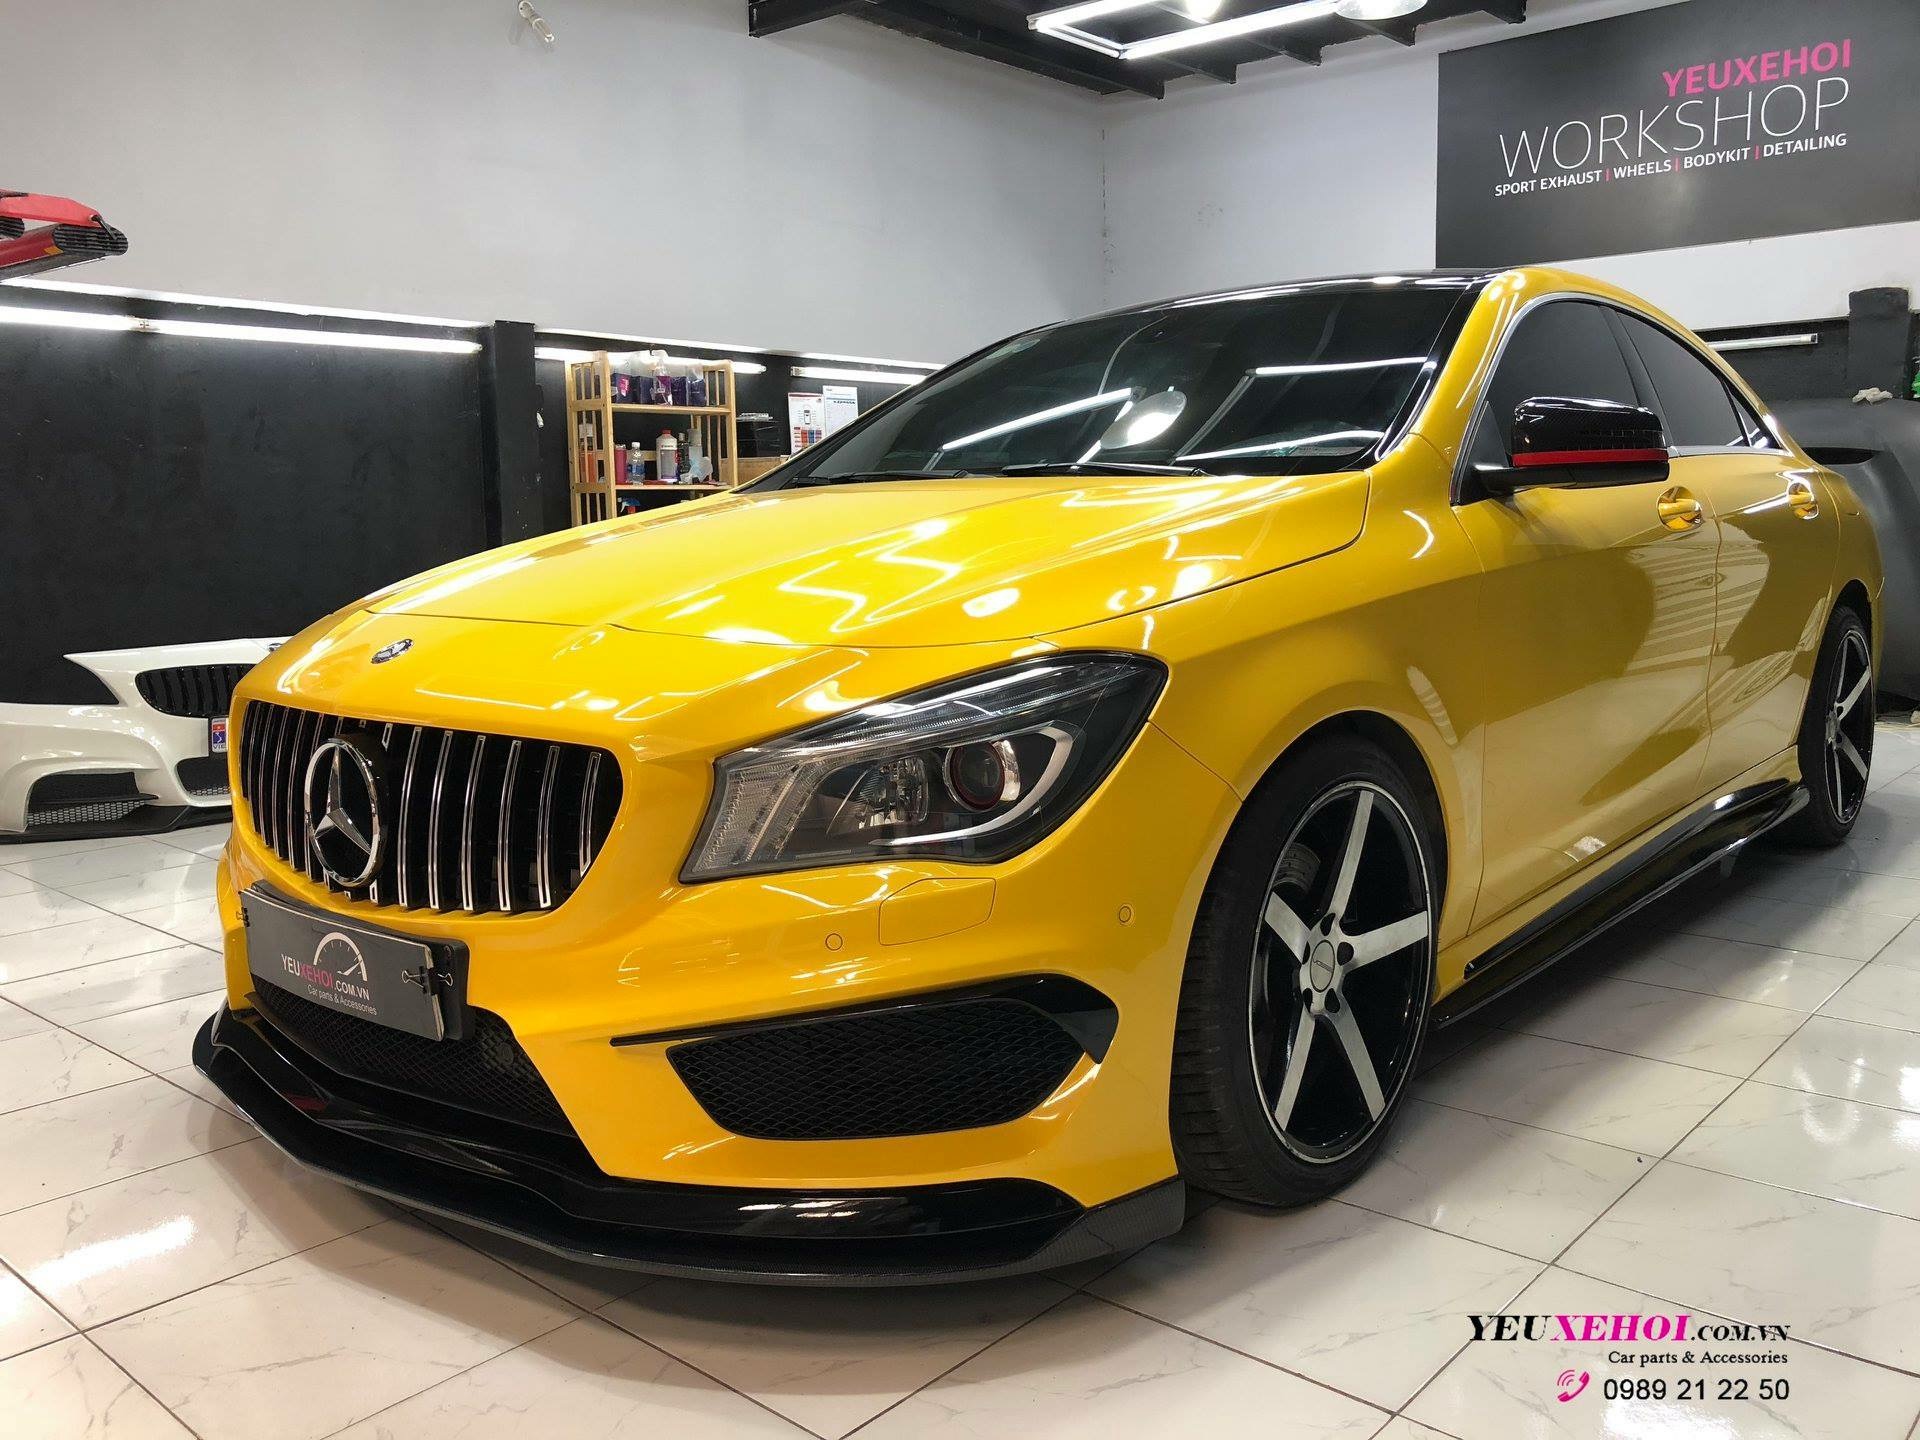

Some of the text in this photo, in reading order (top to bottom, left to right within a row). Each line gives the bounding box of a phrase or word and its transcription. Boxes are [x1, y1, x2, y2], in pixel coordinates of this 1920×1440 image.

[1662, 38, 1852, 97] YEUXEHOI
[1499, 76, 1850, 178] WORKSHOP
[1494, 132, 1847, 197] SPORT EXHAUST WHEELS BODYKIT DETAILING
[307, 984, 319, 996] Car
[319, 990, 334, 1002] parts
[340, 995, 378, 1016] Accessories
